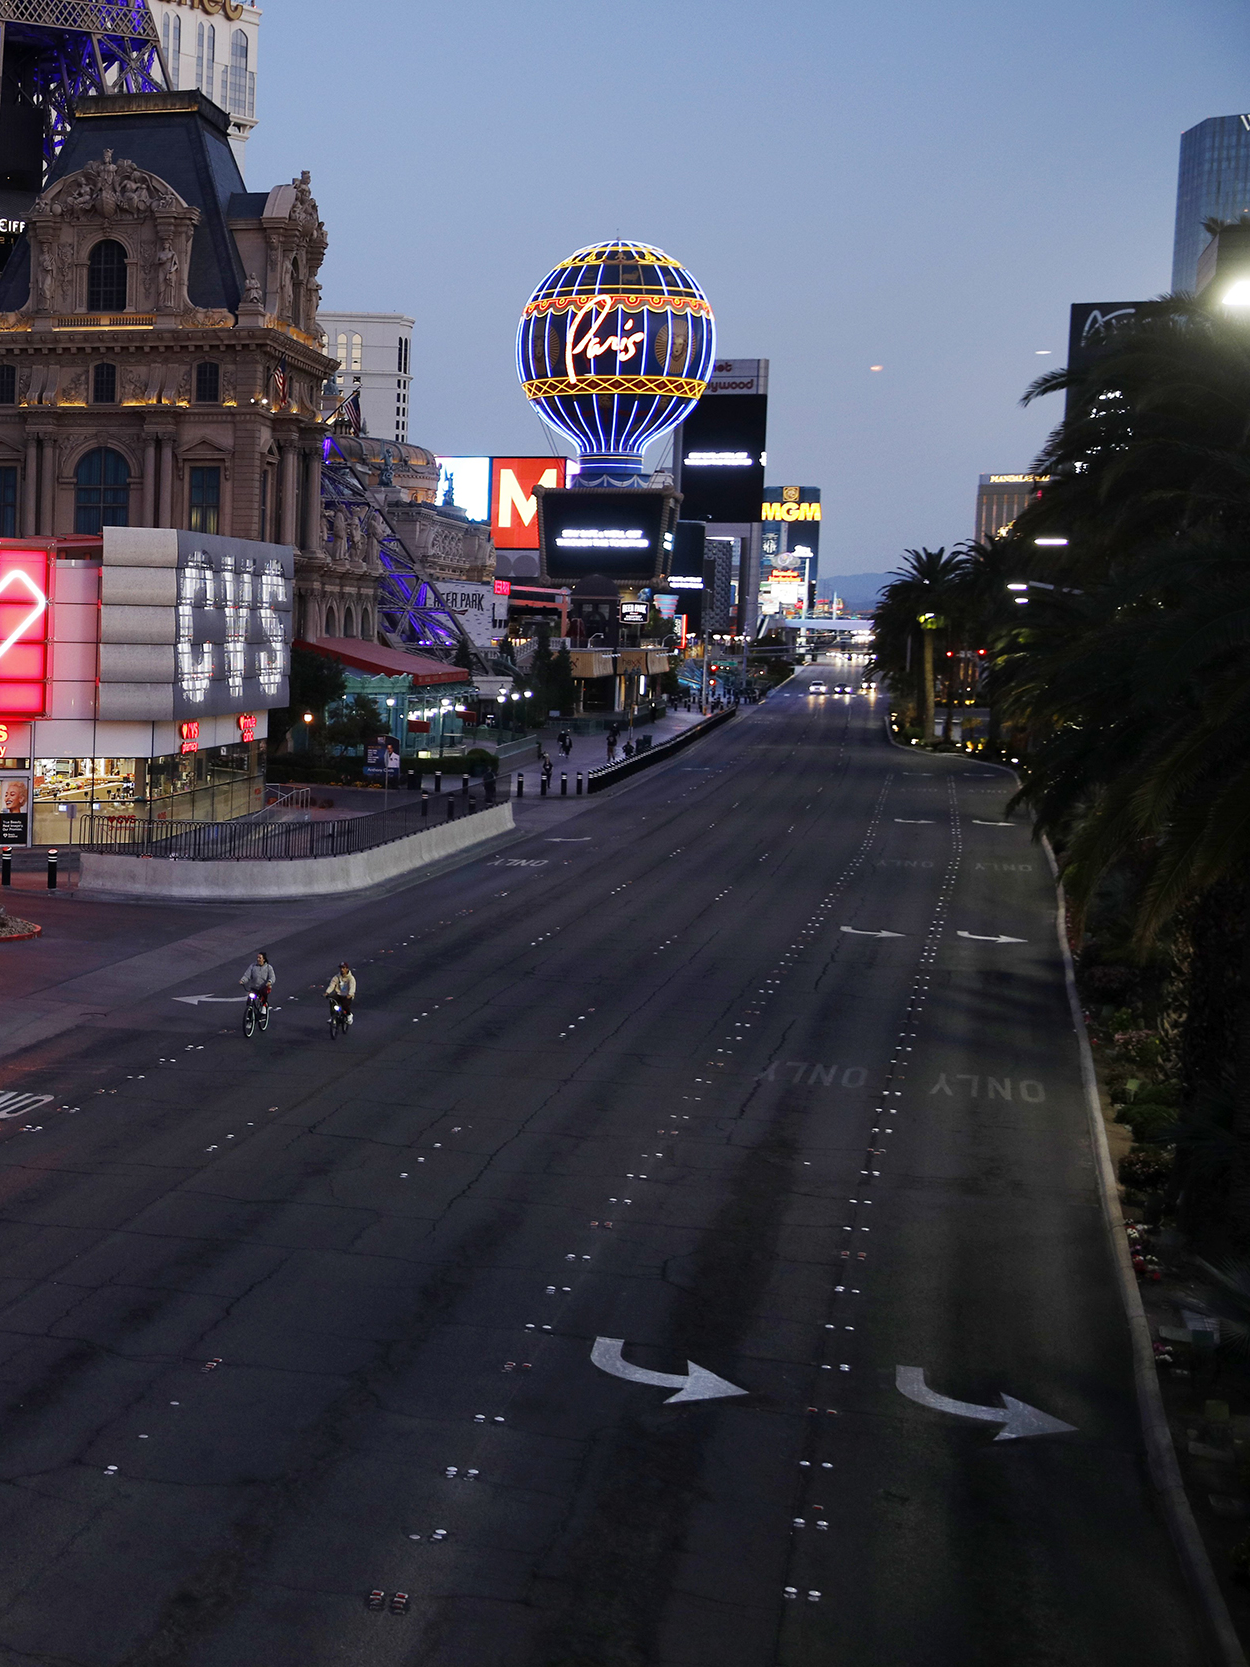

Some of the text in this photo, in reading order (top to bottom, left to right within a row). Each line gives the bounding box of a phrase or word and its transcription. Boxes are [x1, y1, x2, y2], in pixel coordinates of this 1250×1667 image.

[565, 294, 645, 384] Paris
[761, 502, 821, 521] MGM
[460, 592, 485, 612] PARK
[176, 550, 287, 703] CVS
[929, 1072, 1046, 1103] ONLY
